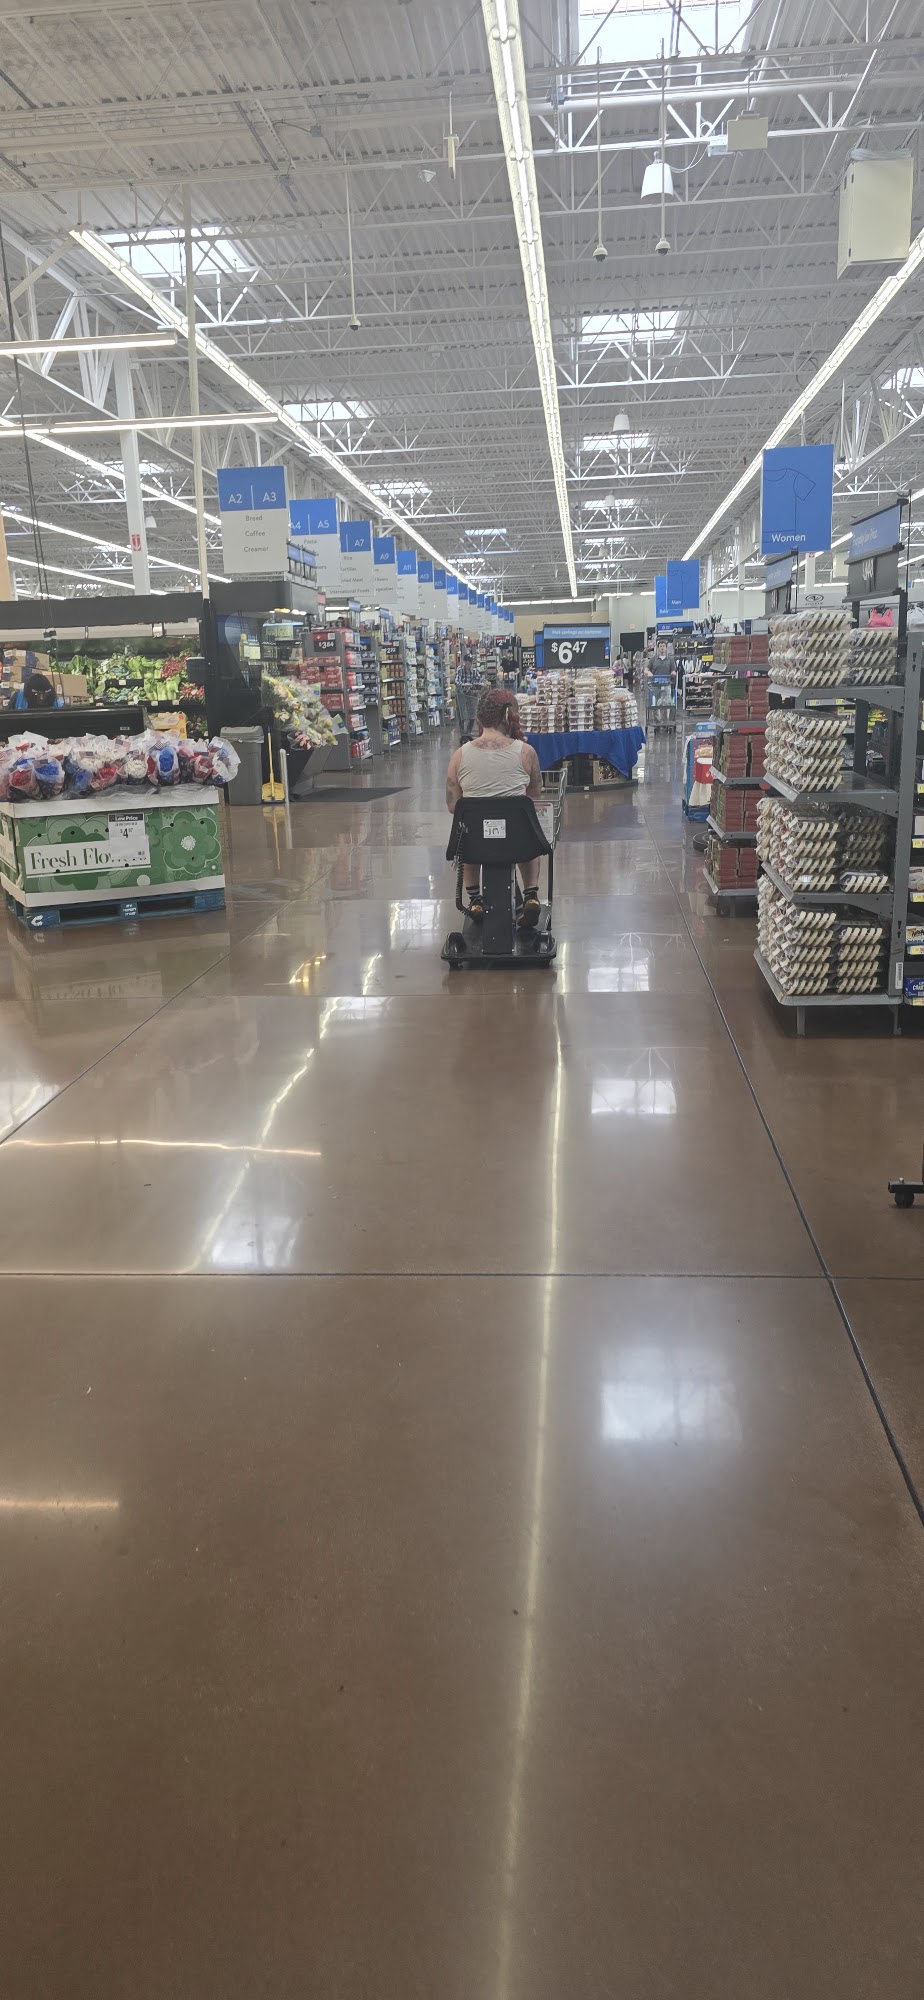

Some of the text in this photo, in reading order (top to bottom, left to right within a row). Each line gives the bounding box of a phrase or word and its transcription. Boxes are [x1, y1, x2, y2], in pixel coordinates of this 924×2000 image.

[228, 491, 277, 504] A2 A3
[317, 519, 330, 529] A5
[354, 539, 365, 547] A7
[771, 533, 806, 543] Women
[379, 552, 390, 561] A9
[30, 850, 77, 870] Fresh
